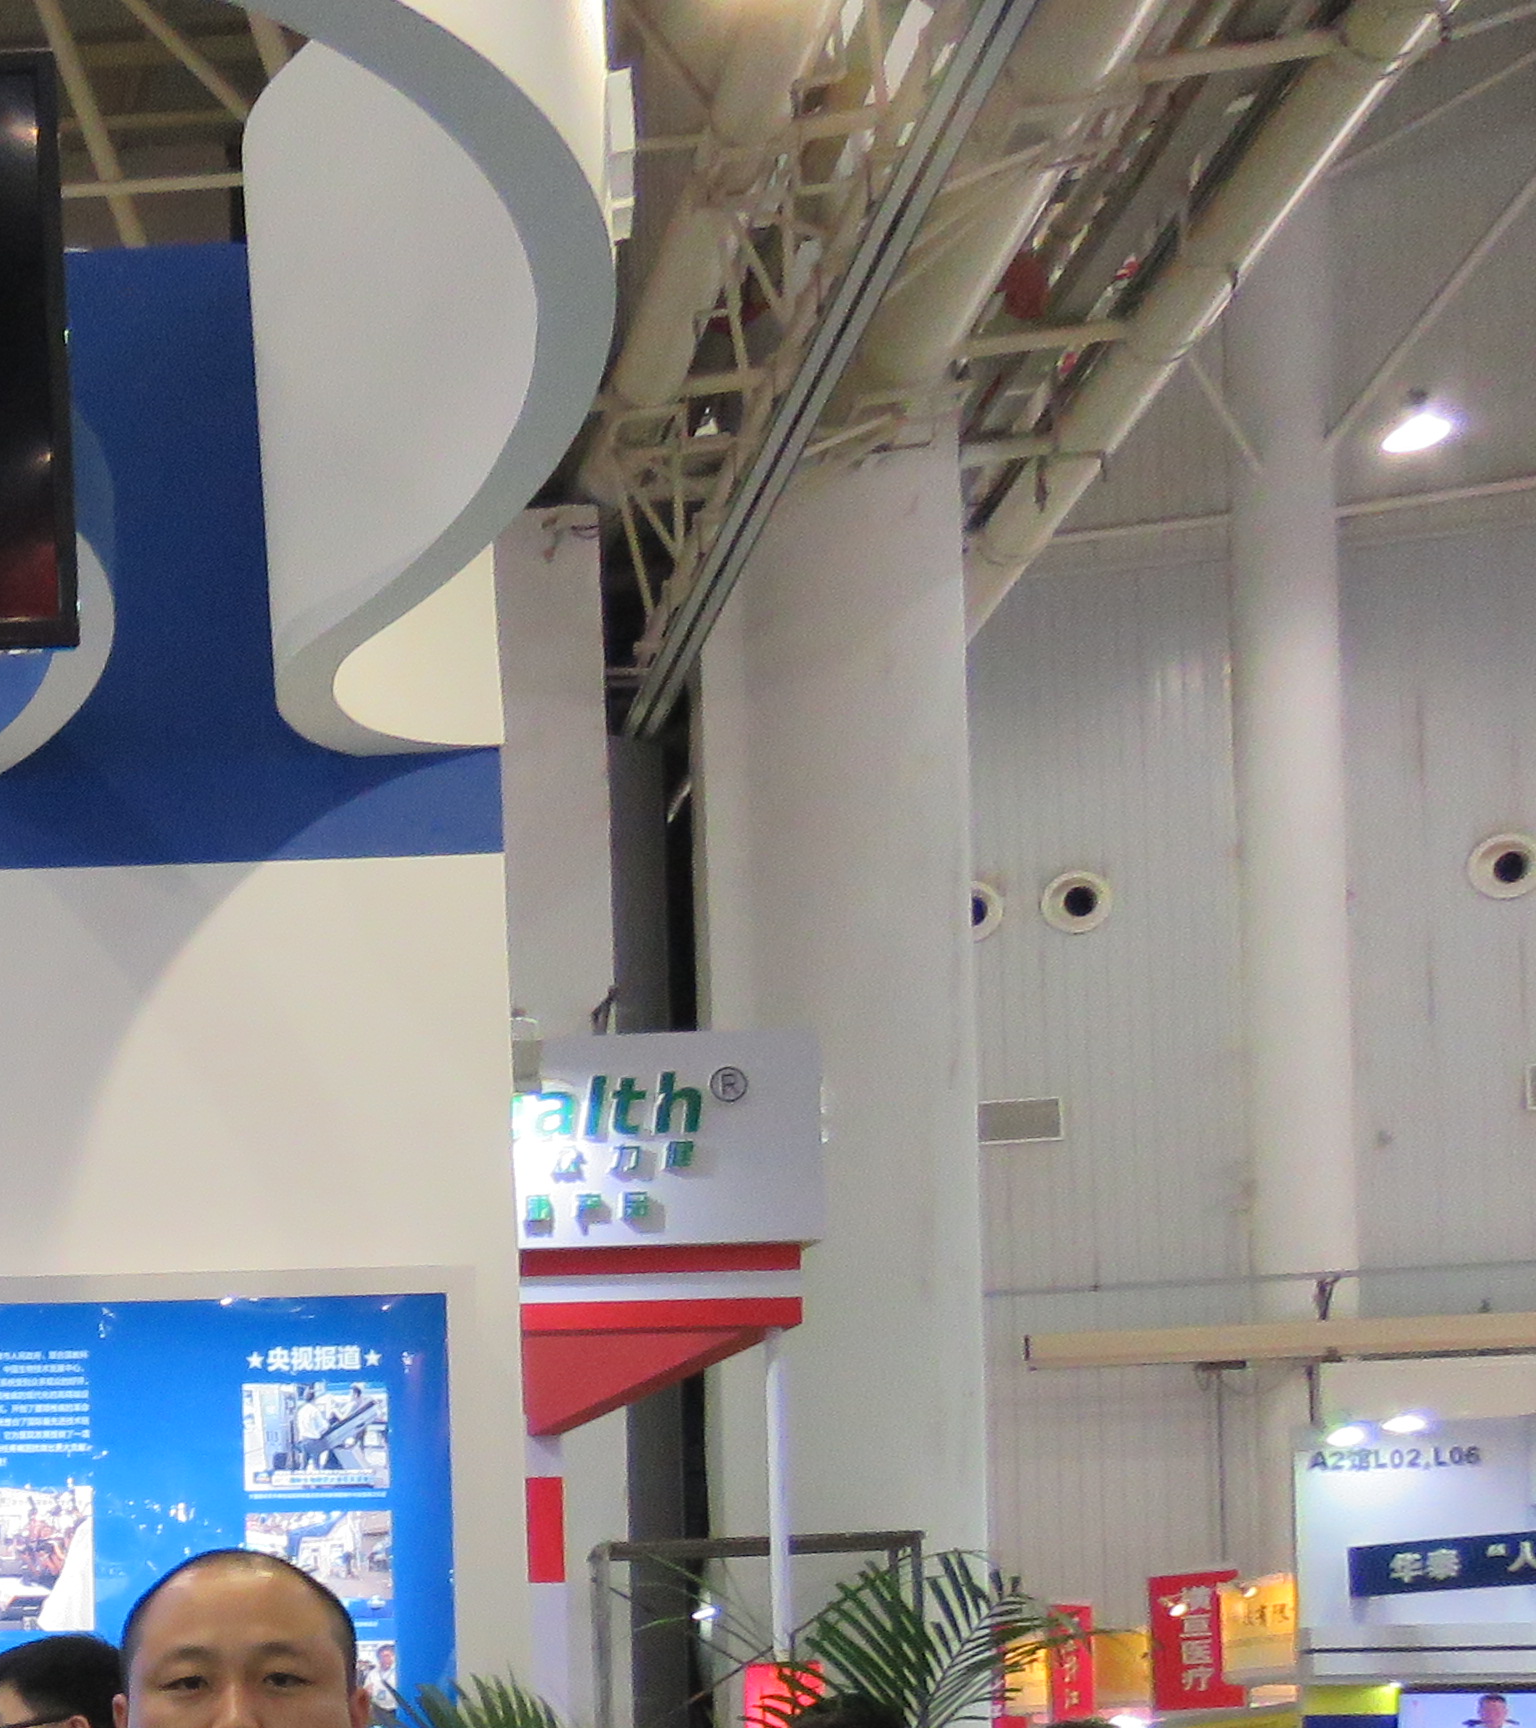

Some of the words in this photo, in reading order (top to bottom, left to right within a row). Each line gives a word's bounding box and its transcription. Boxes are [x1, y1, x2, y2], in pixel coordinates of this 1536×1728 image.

[512, 1071, 702, 1136] alth
[267, 1345, 361, 1371] 央视报道
